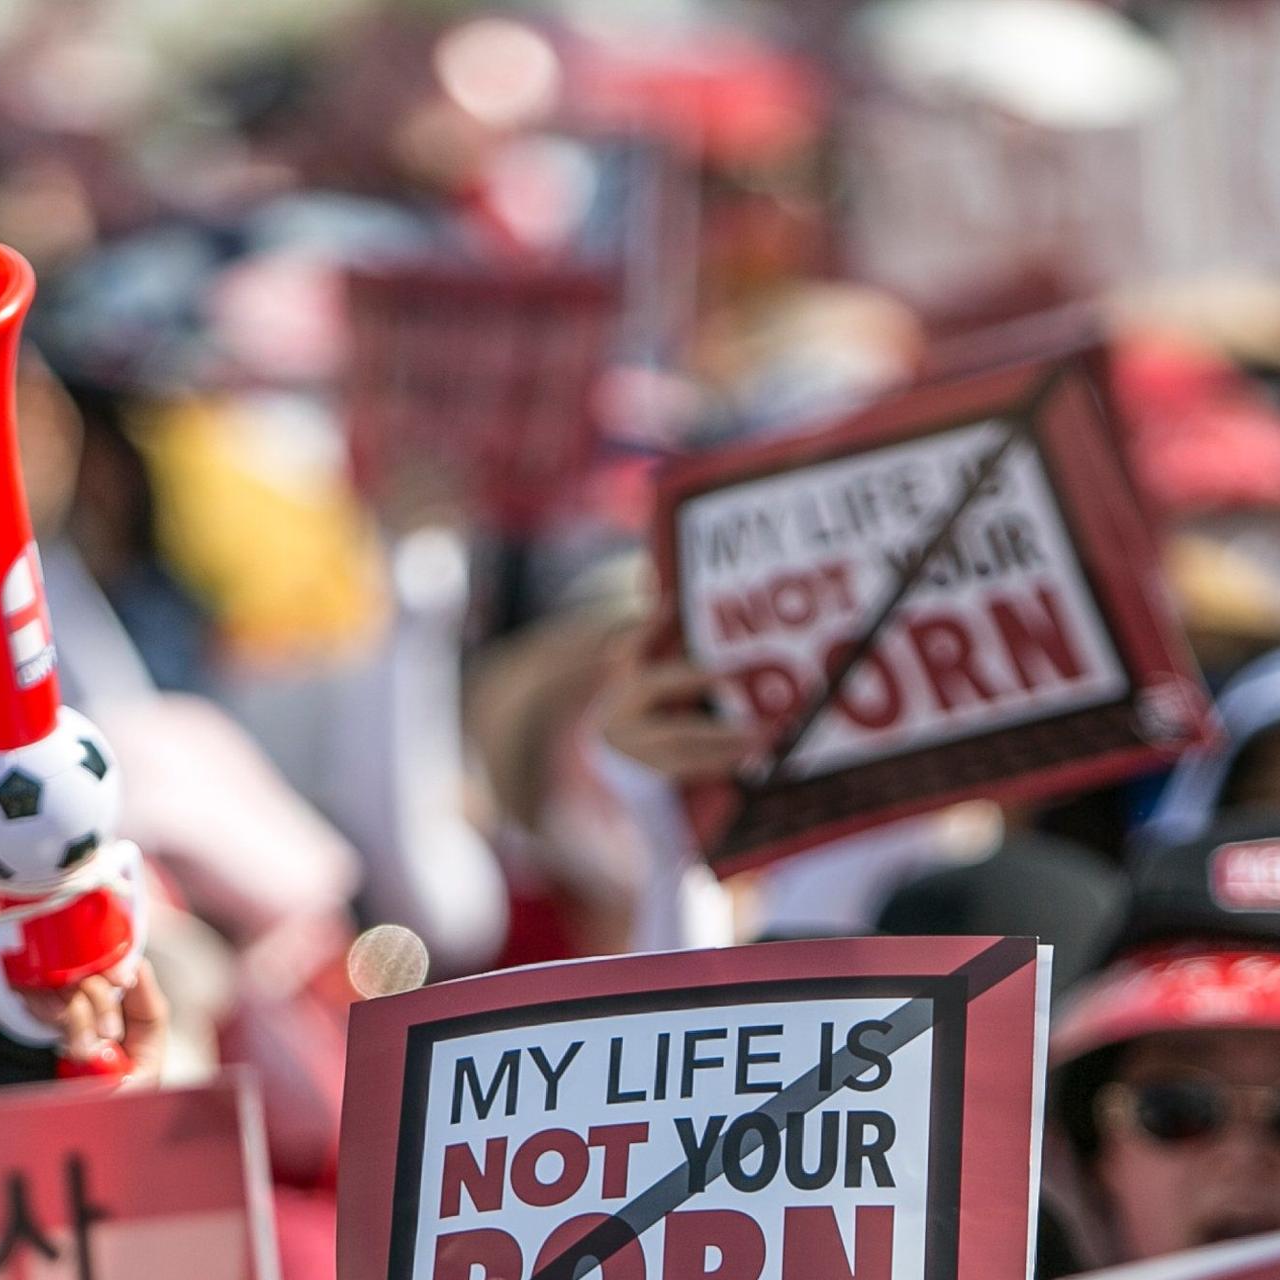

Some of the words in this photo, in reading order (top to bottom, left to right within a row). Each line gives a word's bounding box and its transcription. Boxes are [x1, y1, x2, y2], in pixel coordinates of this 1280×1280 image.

[710, 559, 857, 648] NOT
[742, 581, 1088, 752] PORN
[449, 1040, 586, 1125] MY
[606, 1024, 784, 1105] LIFE
[818, 1018, 894, 1093] IS
[438, 1121, 650, 1219] NOT
[673, 1109, 897, 1194] YOUR
